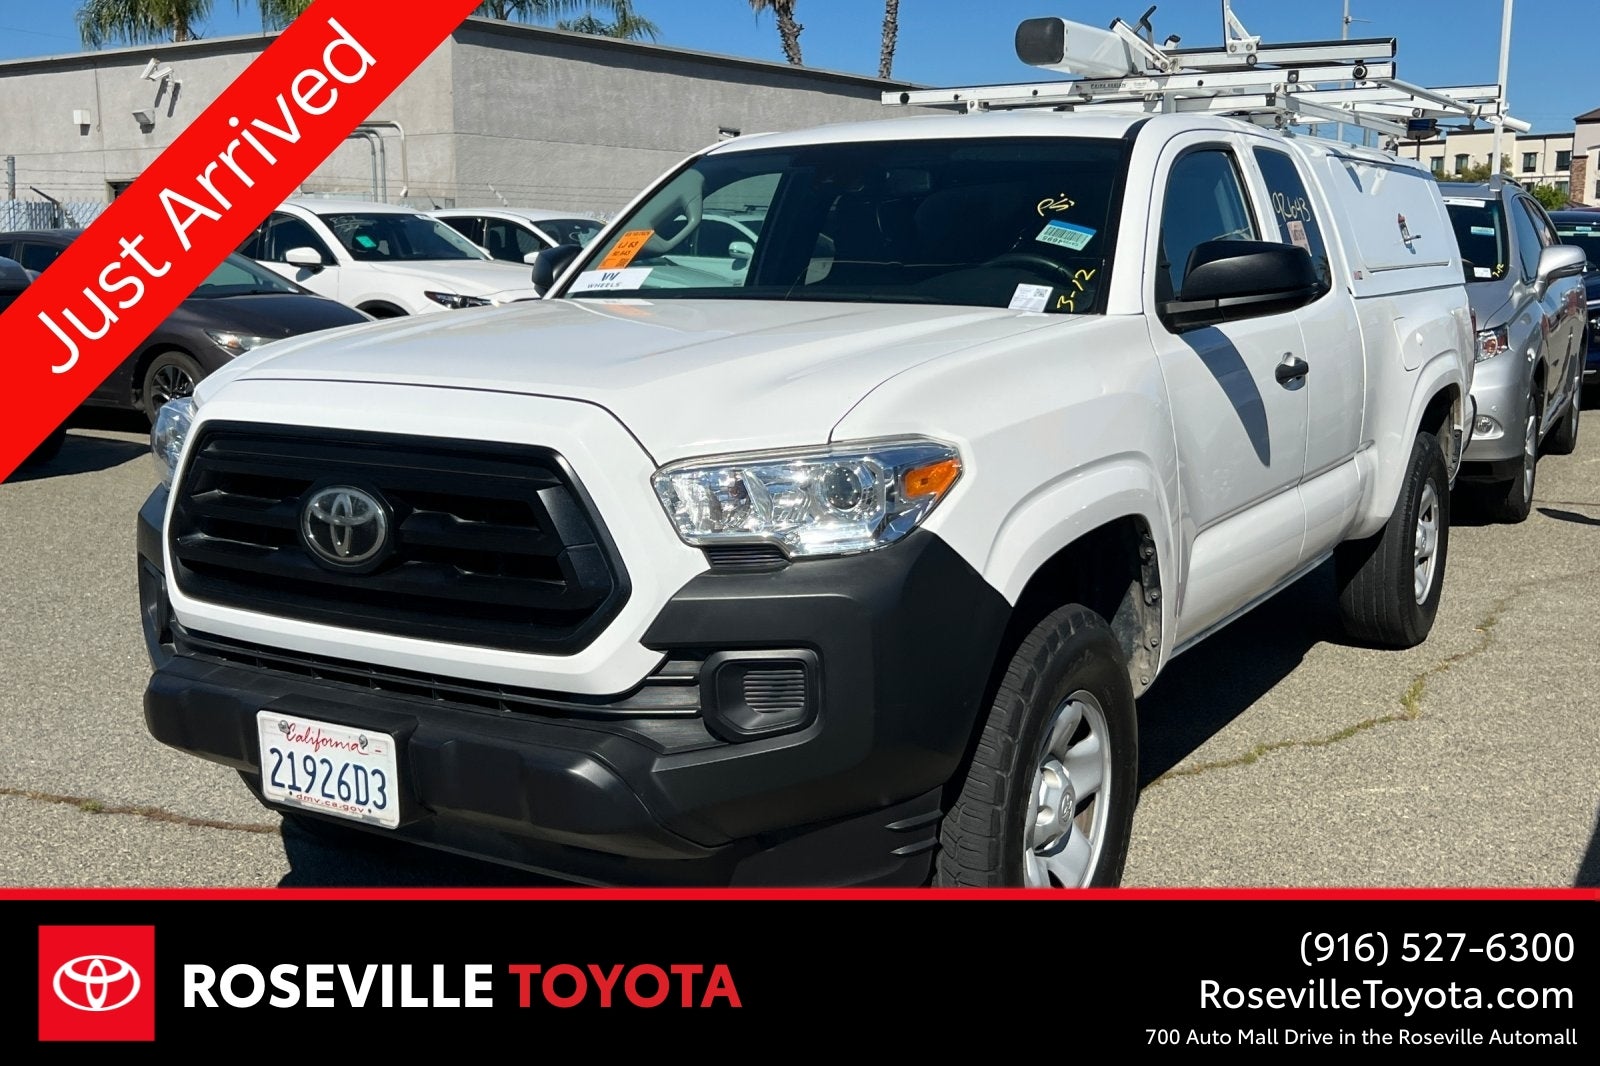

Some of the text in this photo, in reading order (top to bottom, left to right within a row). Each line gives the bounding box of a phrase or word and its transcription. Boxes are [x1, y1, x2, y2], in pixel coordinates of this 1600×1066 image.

[286, 723, 369, 756] California
[269, 747, 387, 810] 21926D3
[296, 794, 365, 814] dmv.ca.gov
